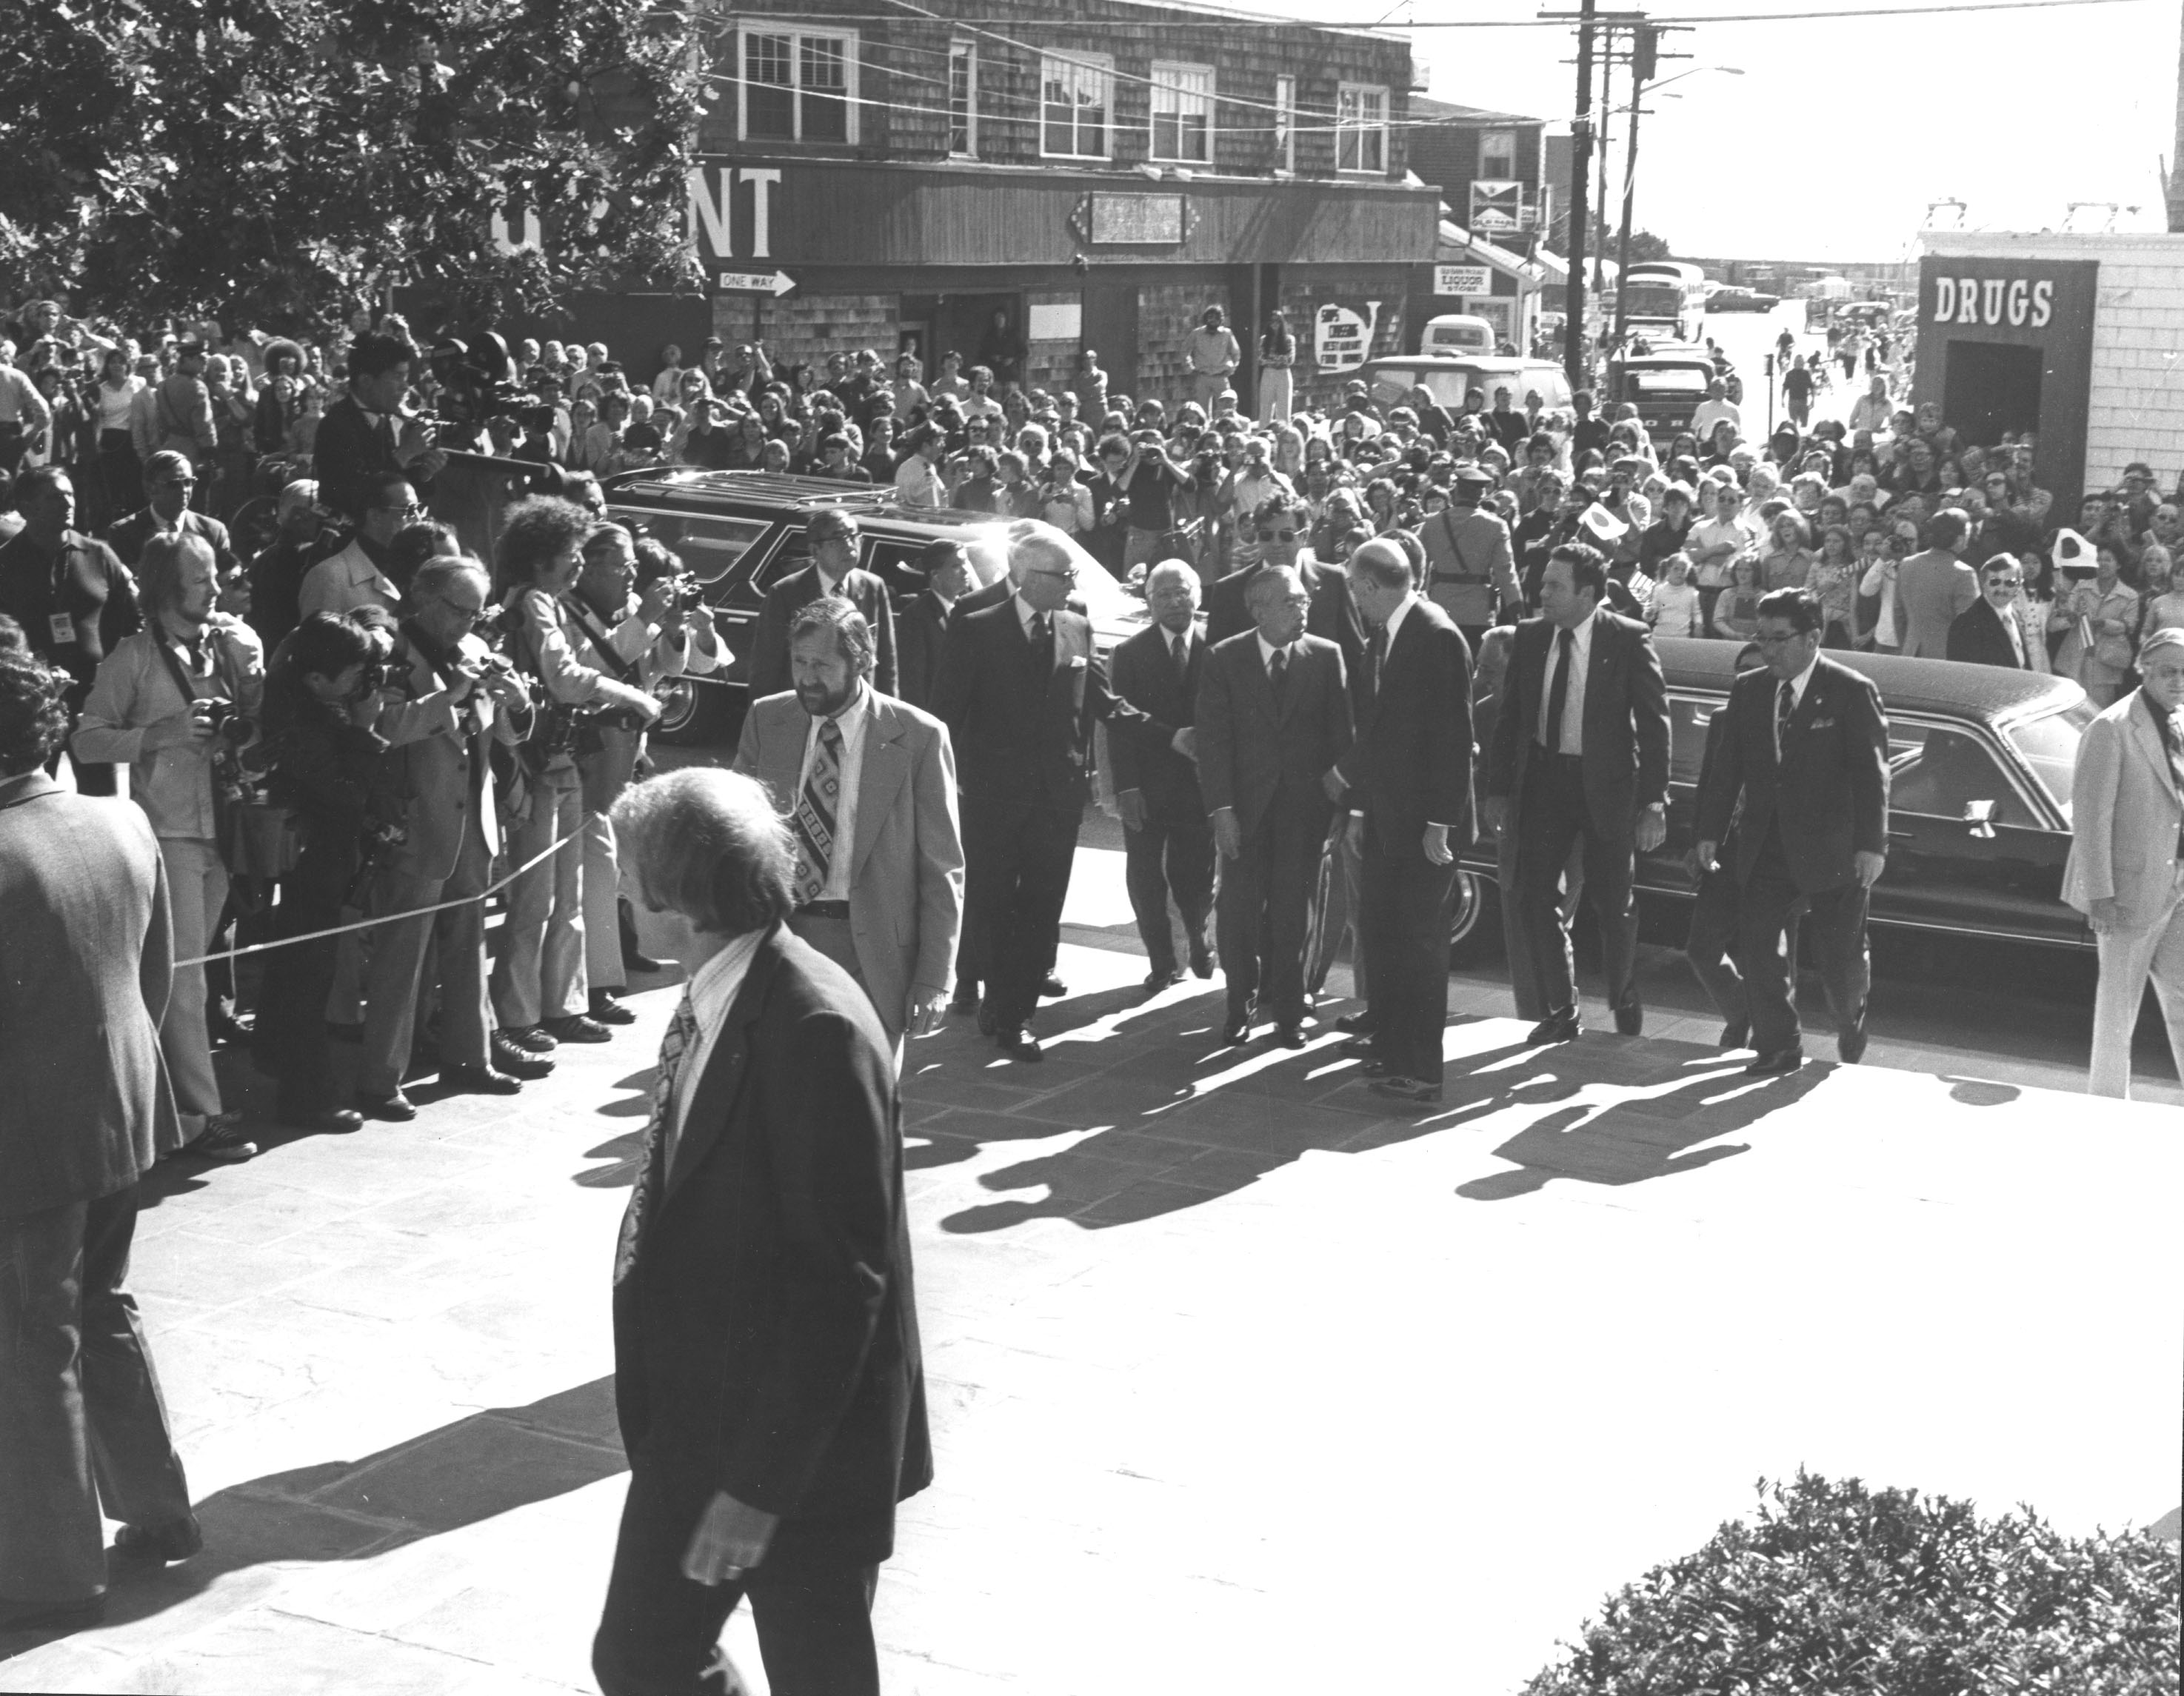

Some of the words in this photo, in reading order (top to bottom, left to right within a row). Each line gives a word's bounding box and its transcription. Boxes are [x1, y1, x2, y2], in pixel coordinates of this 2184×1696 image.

[724, 274, 747, 287] ONE
[751, 276, 775, 288] WAY
[1442, 275, 1484, 285] LIQUOR
[1934, 277, 2053, 327] DRUGS
